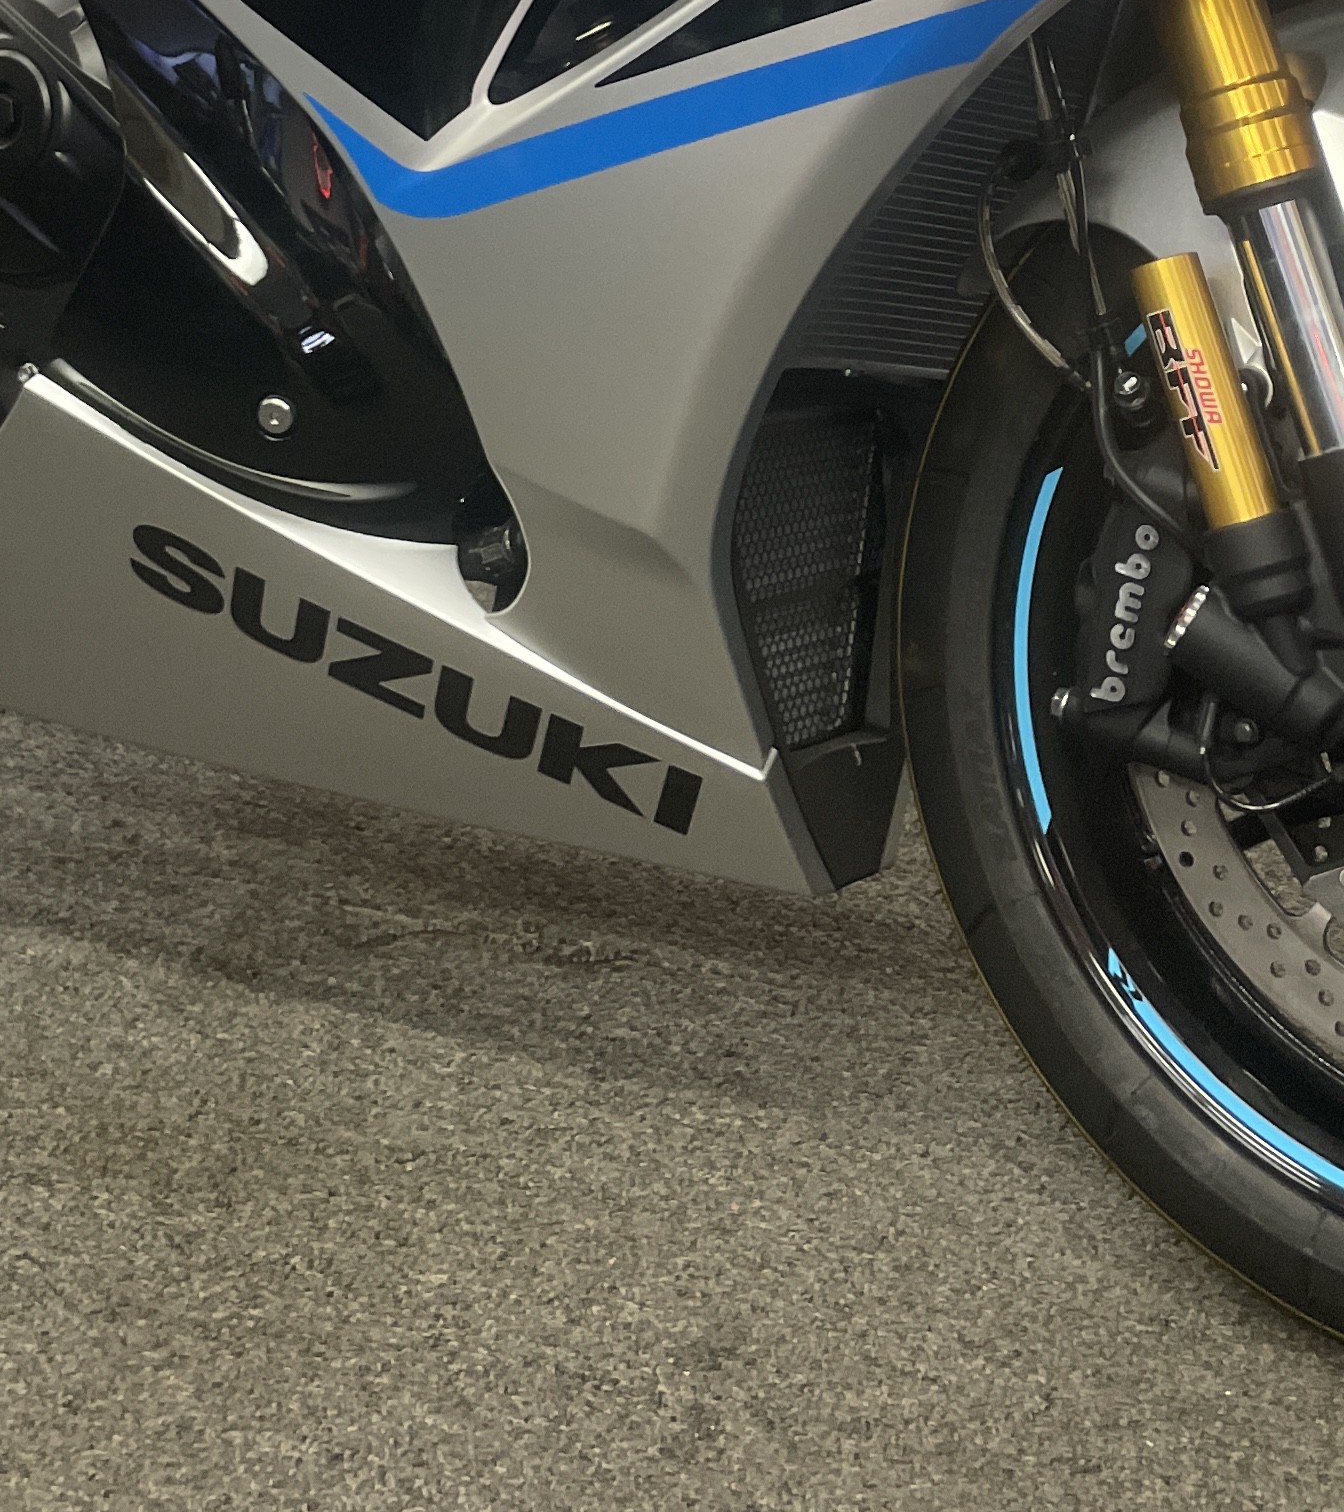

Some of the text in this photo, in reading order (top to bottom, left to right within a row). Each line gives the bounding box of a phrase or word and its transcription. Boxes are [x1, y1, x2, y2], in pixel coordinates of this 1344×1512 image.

[1185, 346, 1223, 425] SHOWA
[130, 523, 704, 836] SUZUKI
[1091, 523, 1160, 704] brembo
